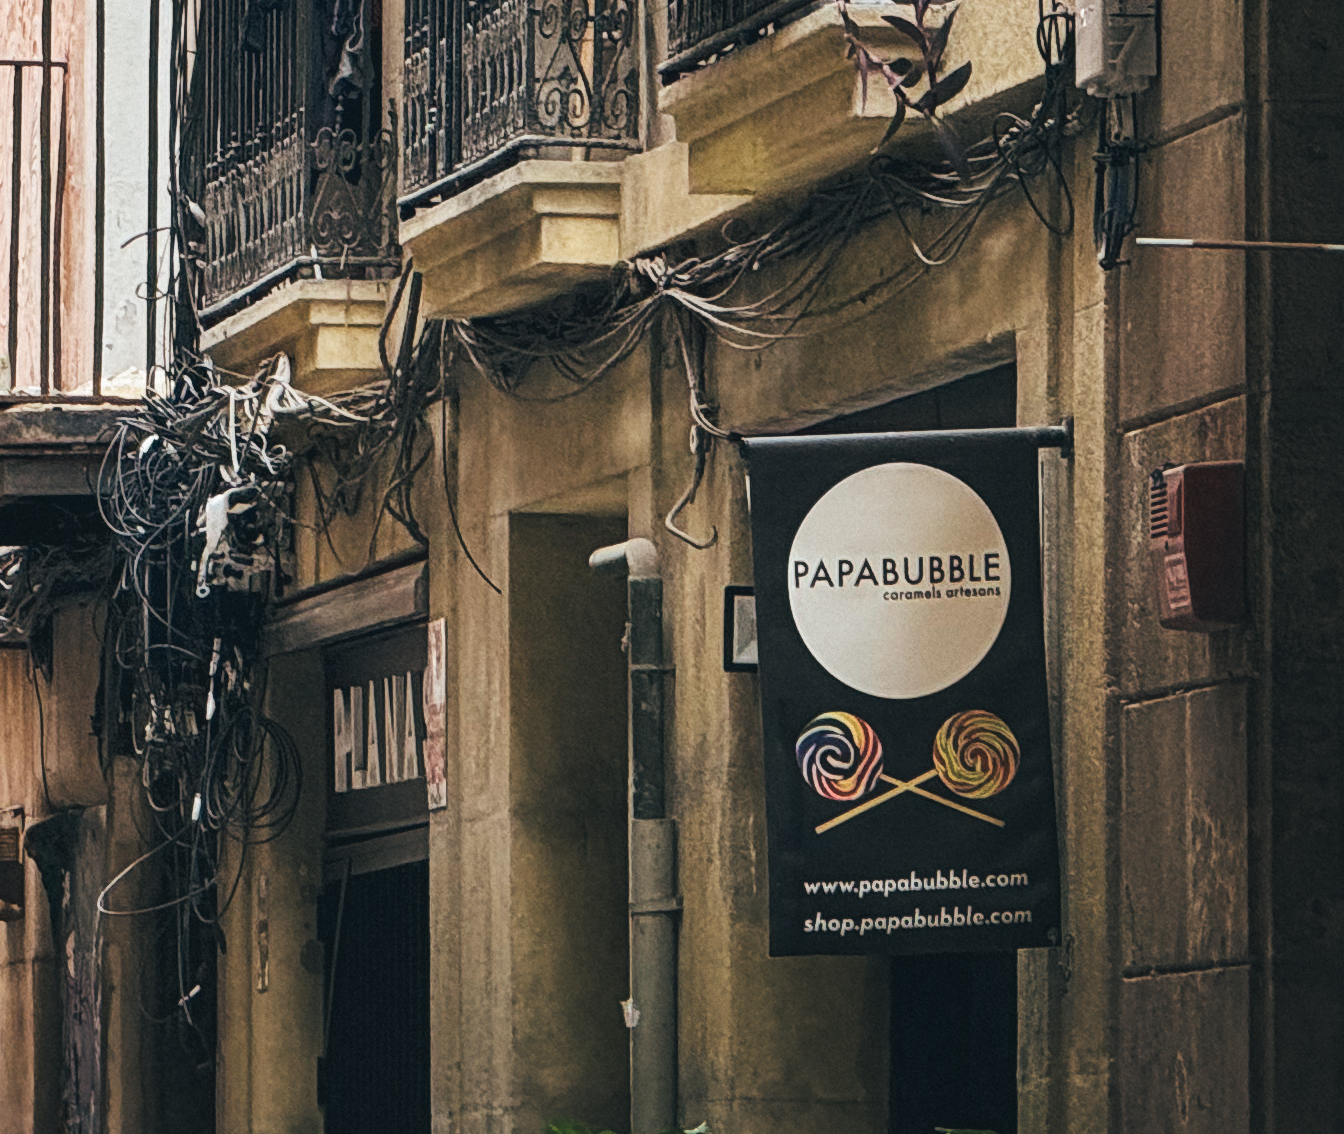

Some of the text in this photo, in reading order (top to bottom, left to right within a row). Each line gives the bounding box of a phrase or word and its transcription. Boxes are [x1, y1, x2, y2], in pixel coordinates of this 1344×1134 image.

[793, 552, 1001, 589] PAPABUBBLE
[883, 584, 1001, 601] caramels artesans
[803, 868, 1029, 899] www.papabubble.com
[803, 905, 1033, 937] shop.papabubble.com
